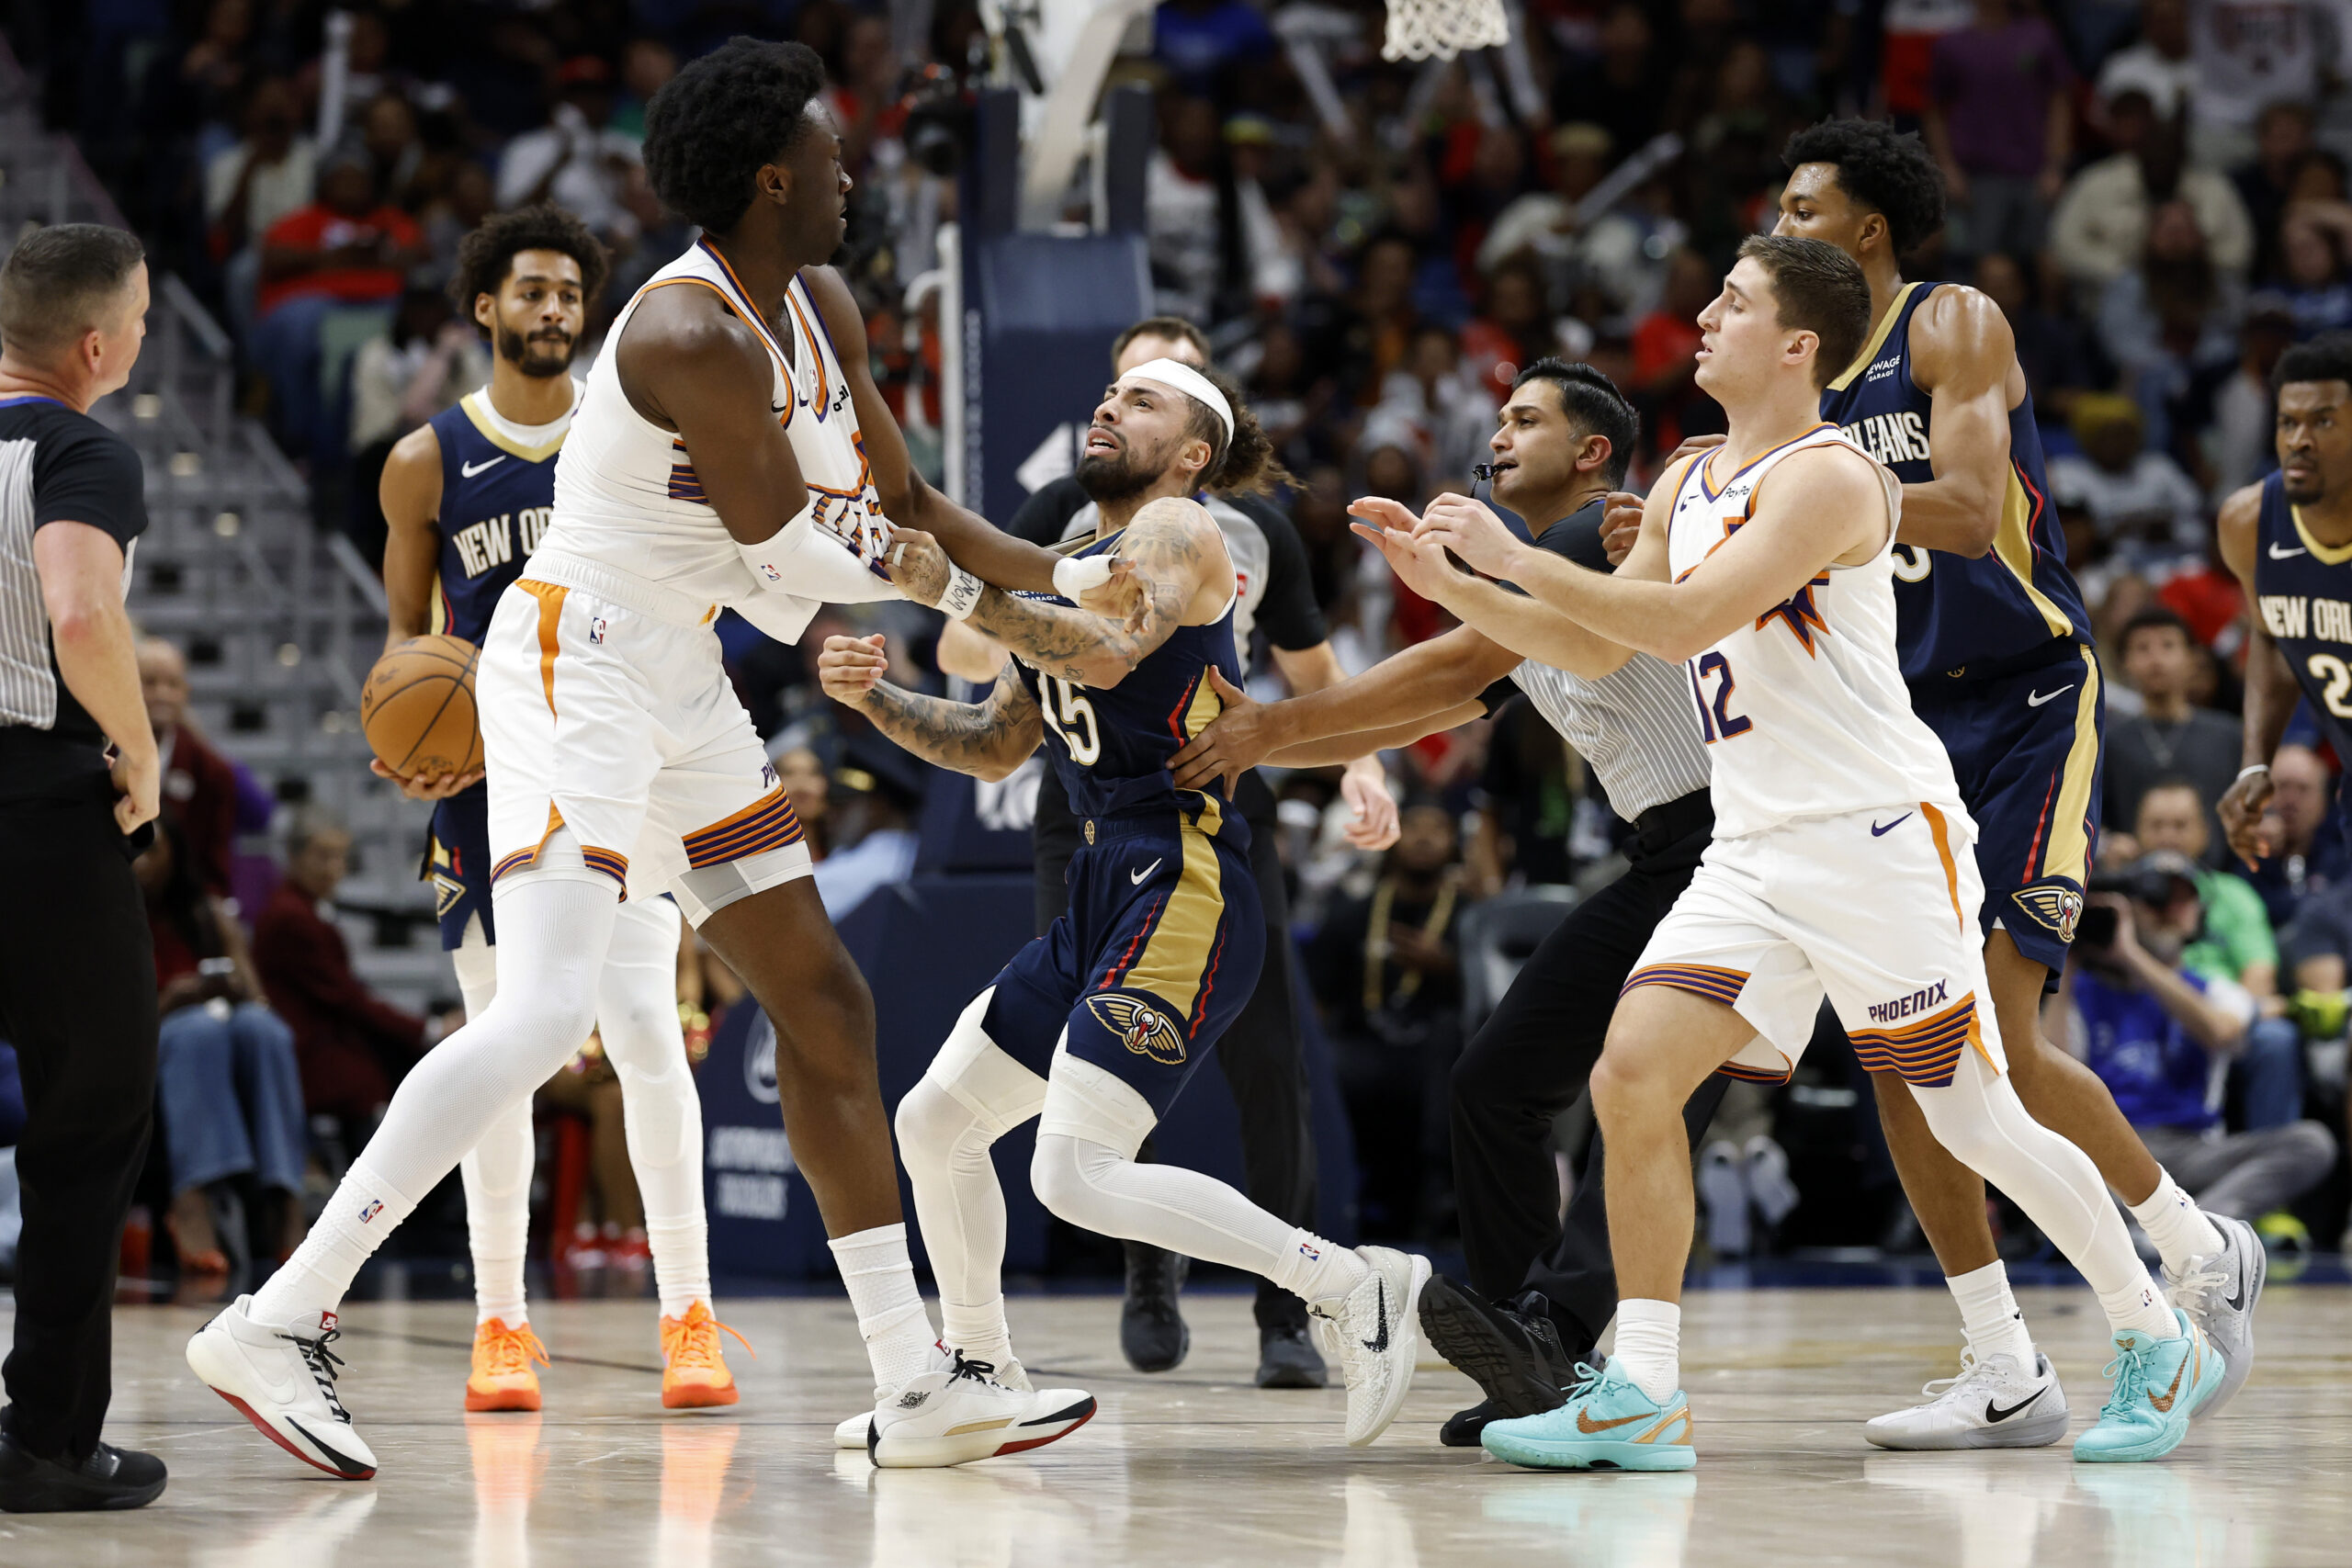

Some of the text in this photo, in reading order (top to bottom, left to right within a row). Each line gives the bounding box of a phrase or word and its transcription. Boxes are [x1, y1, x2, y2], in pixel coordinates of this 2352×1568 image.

[1868, 368, 1894, 382] GARAGE
[452, 513, 512, 580] NEW
[1036, 669, 1101, 766] 15
[1687, 650, 1753, 745] 12
[2307, 653, 2352, 718] 2
[1868, 977, 1949, 1022] PHOENIX
